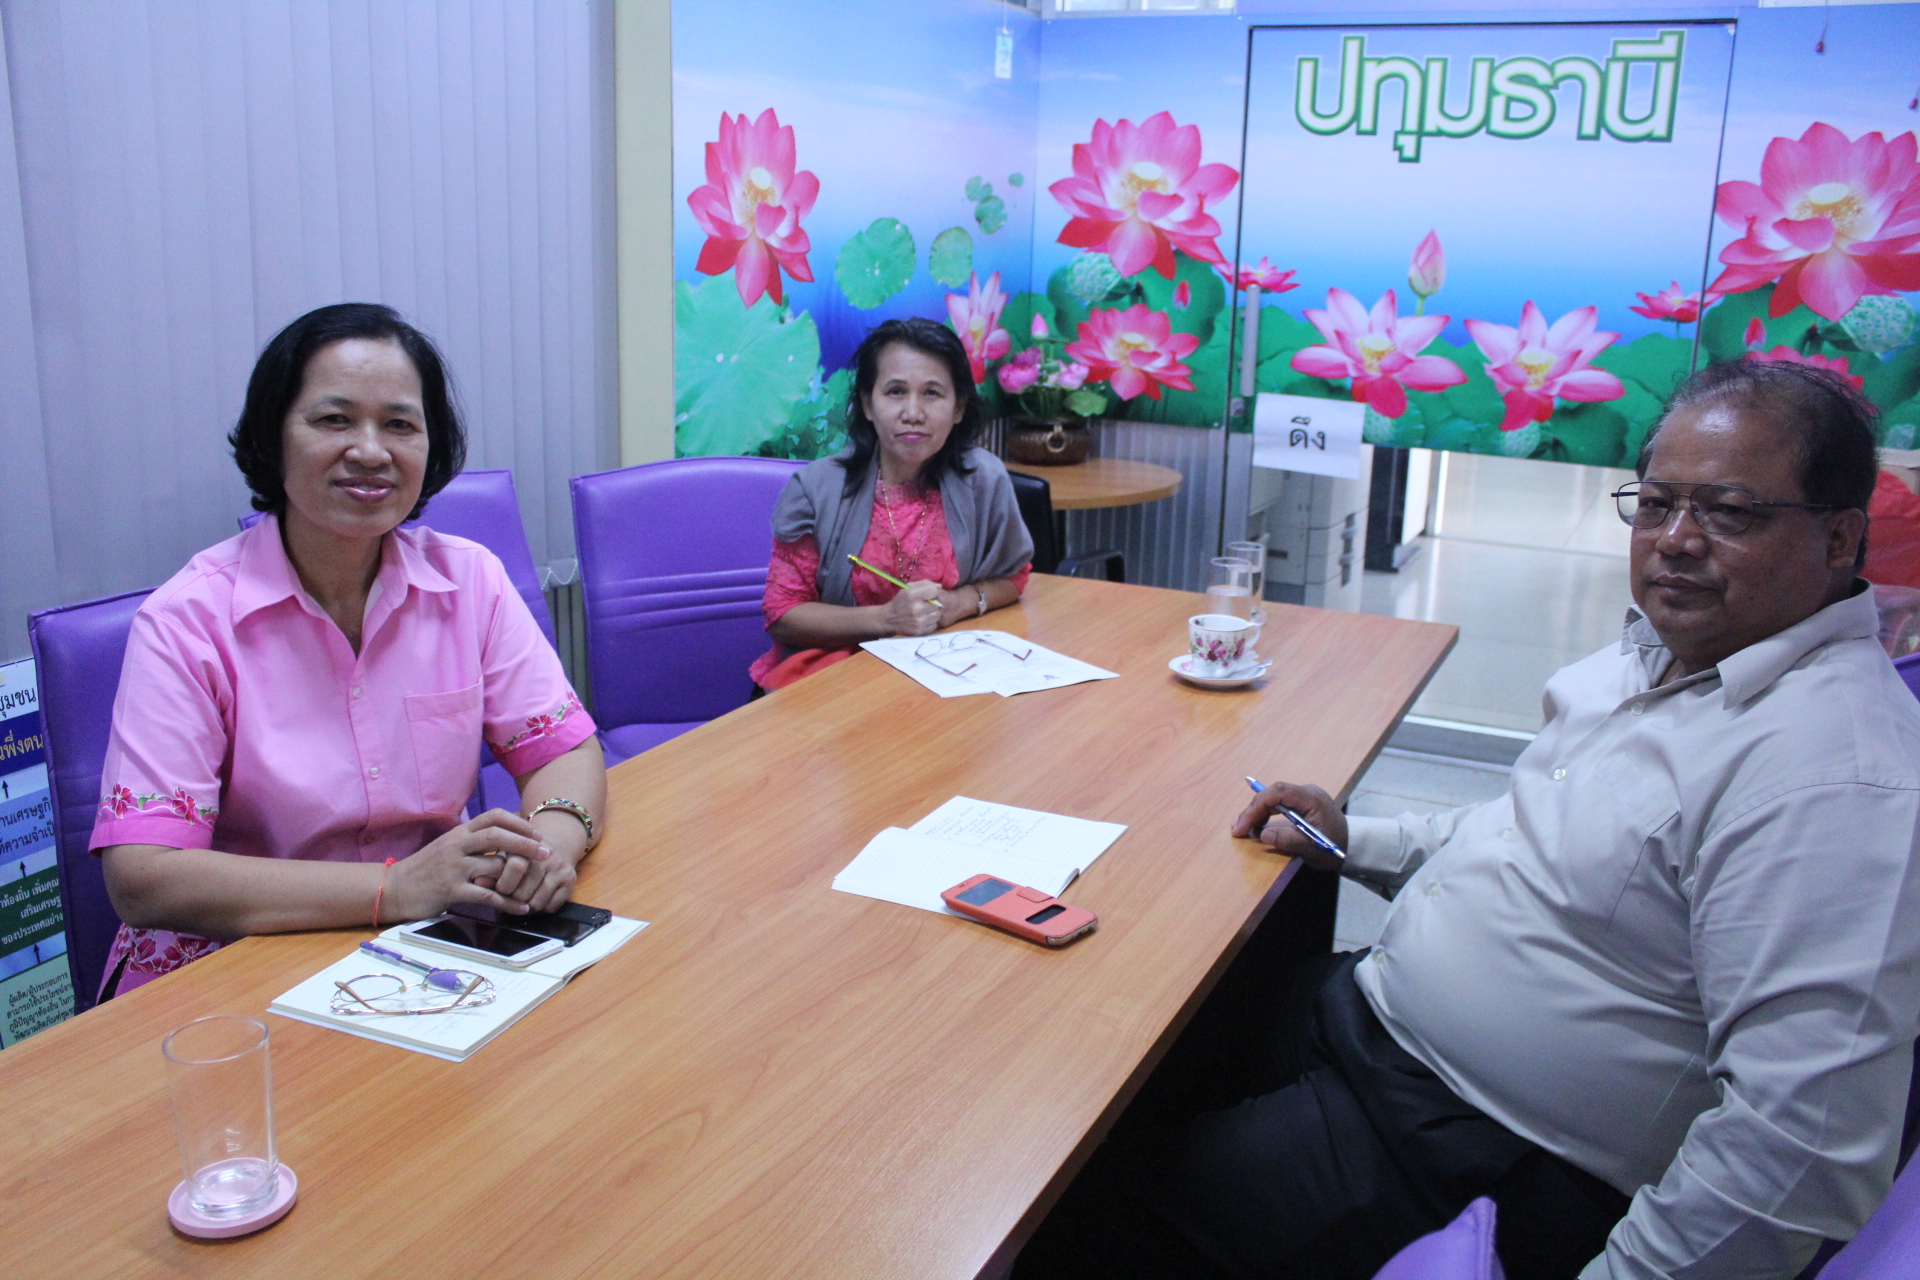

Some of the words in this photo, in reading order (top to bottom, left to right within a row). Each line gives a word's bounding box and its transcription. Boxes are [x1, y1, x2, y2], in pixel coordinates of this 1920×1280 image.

[1294, 29, 1686, 163] ปทุมธานี
[1289, 416, 1326, 451] ดึง
